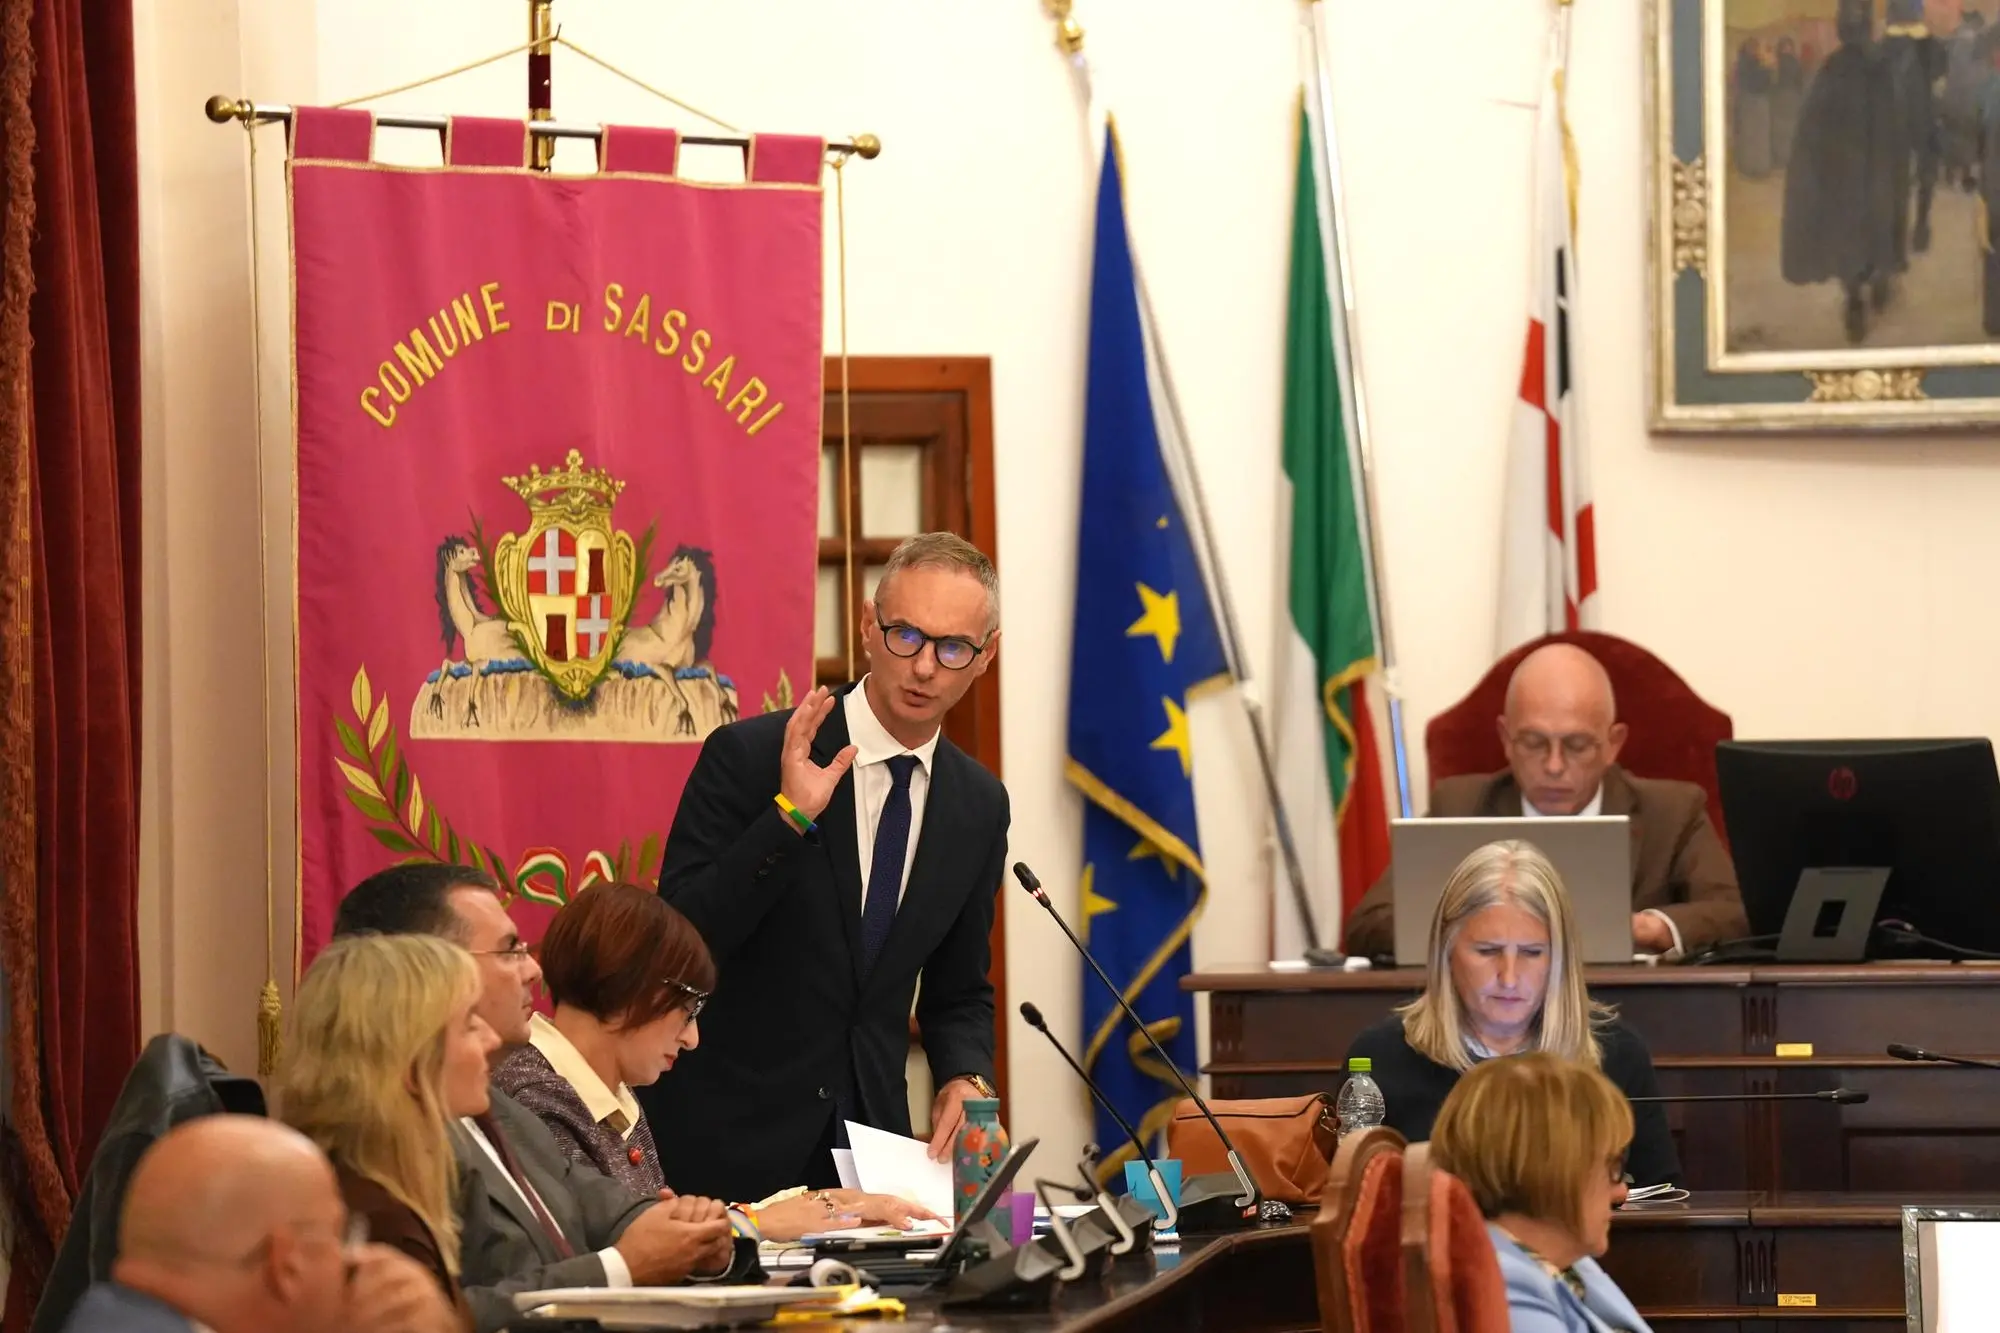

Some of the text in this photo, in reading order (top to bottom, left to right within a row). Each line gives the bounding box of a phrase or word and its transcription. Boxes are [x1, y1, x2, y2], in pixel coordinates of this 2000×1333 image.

[360, 282, 784, 436] COMUNE DI SASSARI
